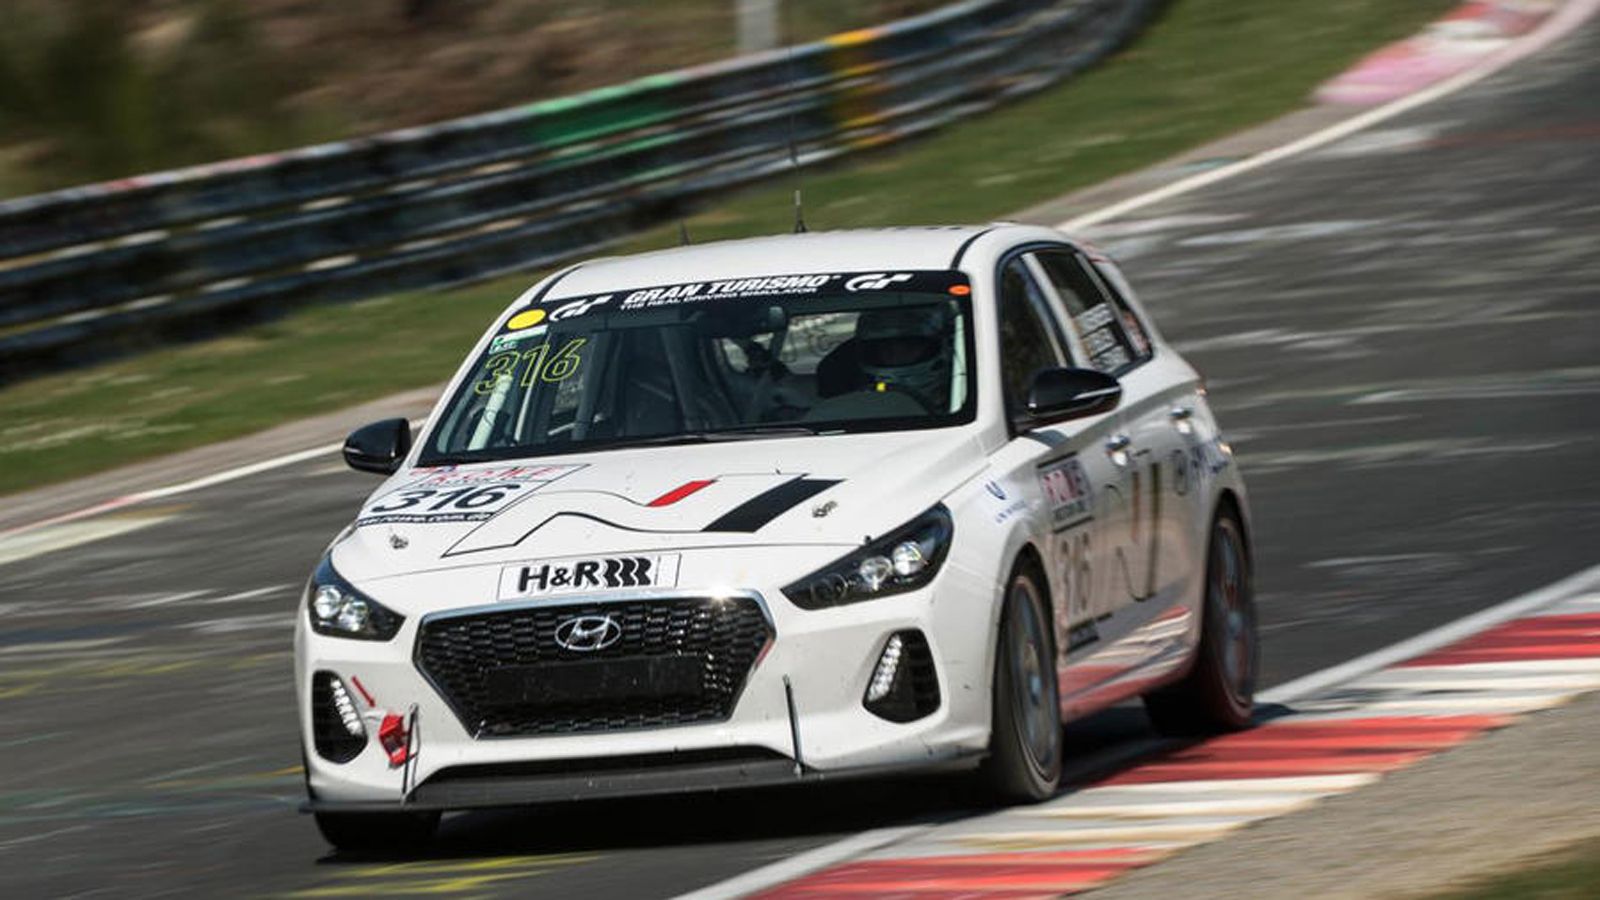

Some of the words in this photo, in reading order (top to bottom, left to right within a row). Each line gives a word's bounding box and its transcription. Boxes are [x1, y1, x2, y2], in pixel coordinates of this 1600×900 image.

[623, 281, 704, 304] GRAN
[707, 274, 829, 295] TURISMO
[474, 338, 587, 394] 316
[371, 484, 521, 513] 316
[518, 560, 600, 592] H&R
